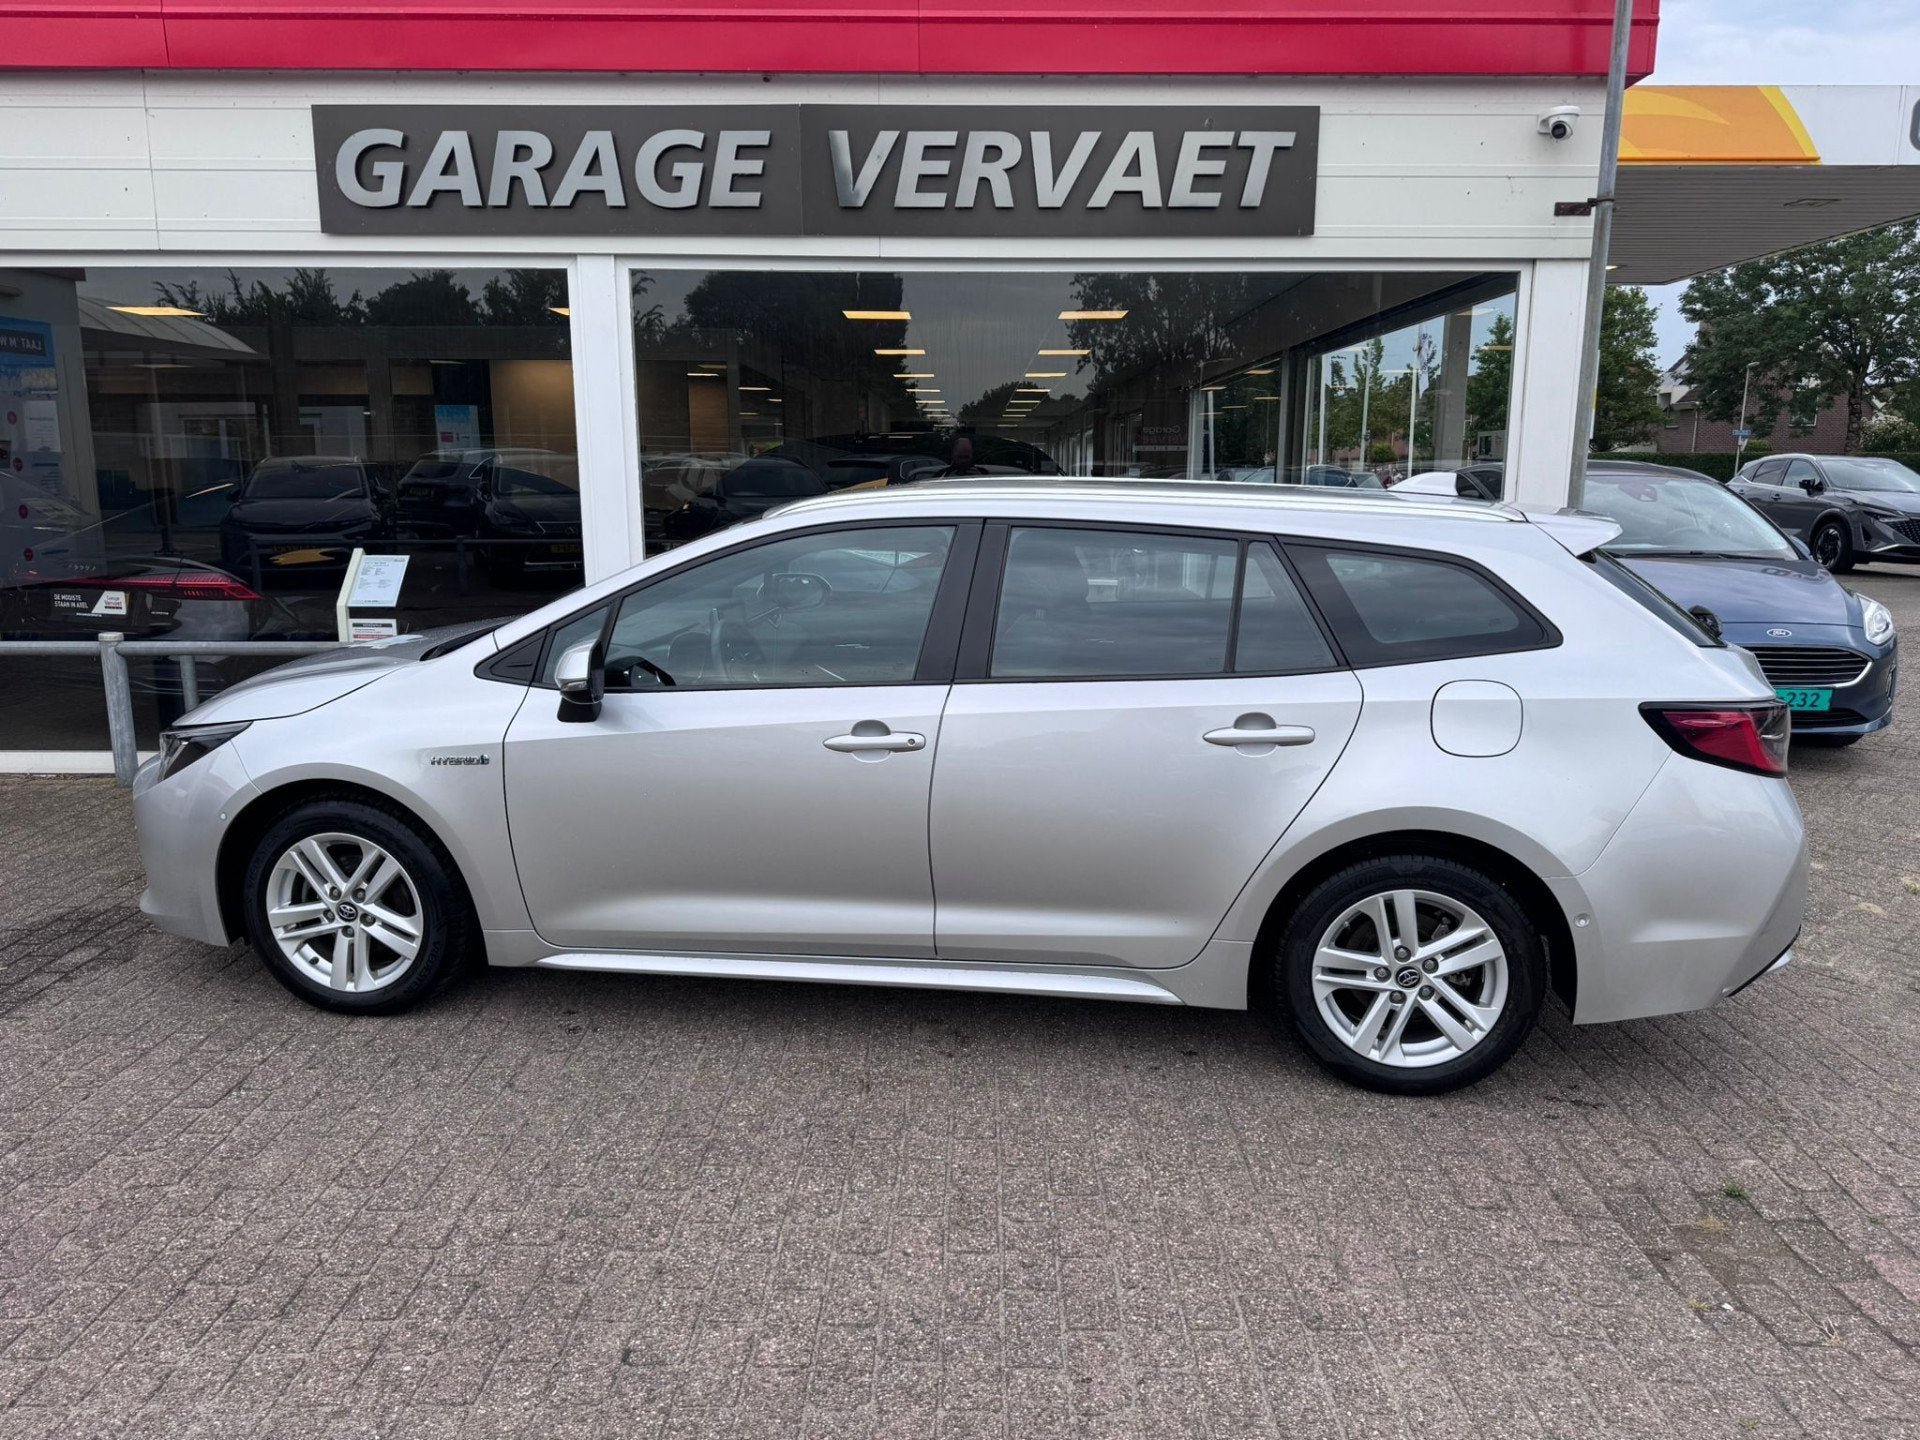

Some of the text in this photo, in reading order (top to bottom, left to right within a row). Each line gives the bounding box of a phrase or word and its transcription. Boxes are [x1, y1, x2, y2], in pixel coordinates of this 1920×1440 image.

[335, 128, 1297, 209] GARAGE VERVAET
[430, 756, 480, 766] HYBRID
